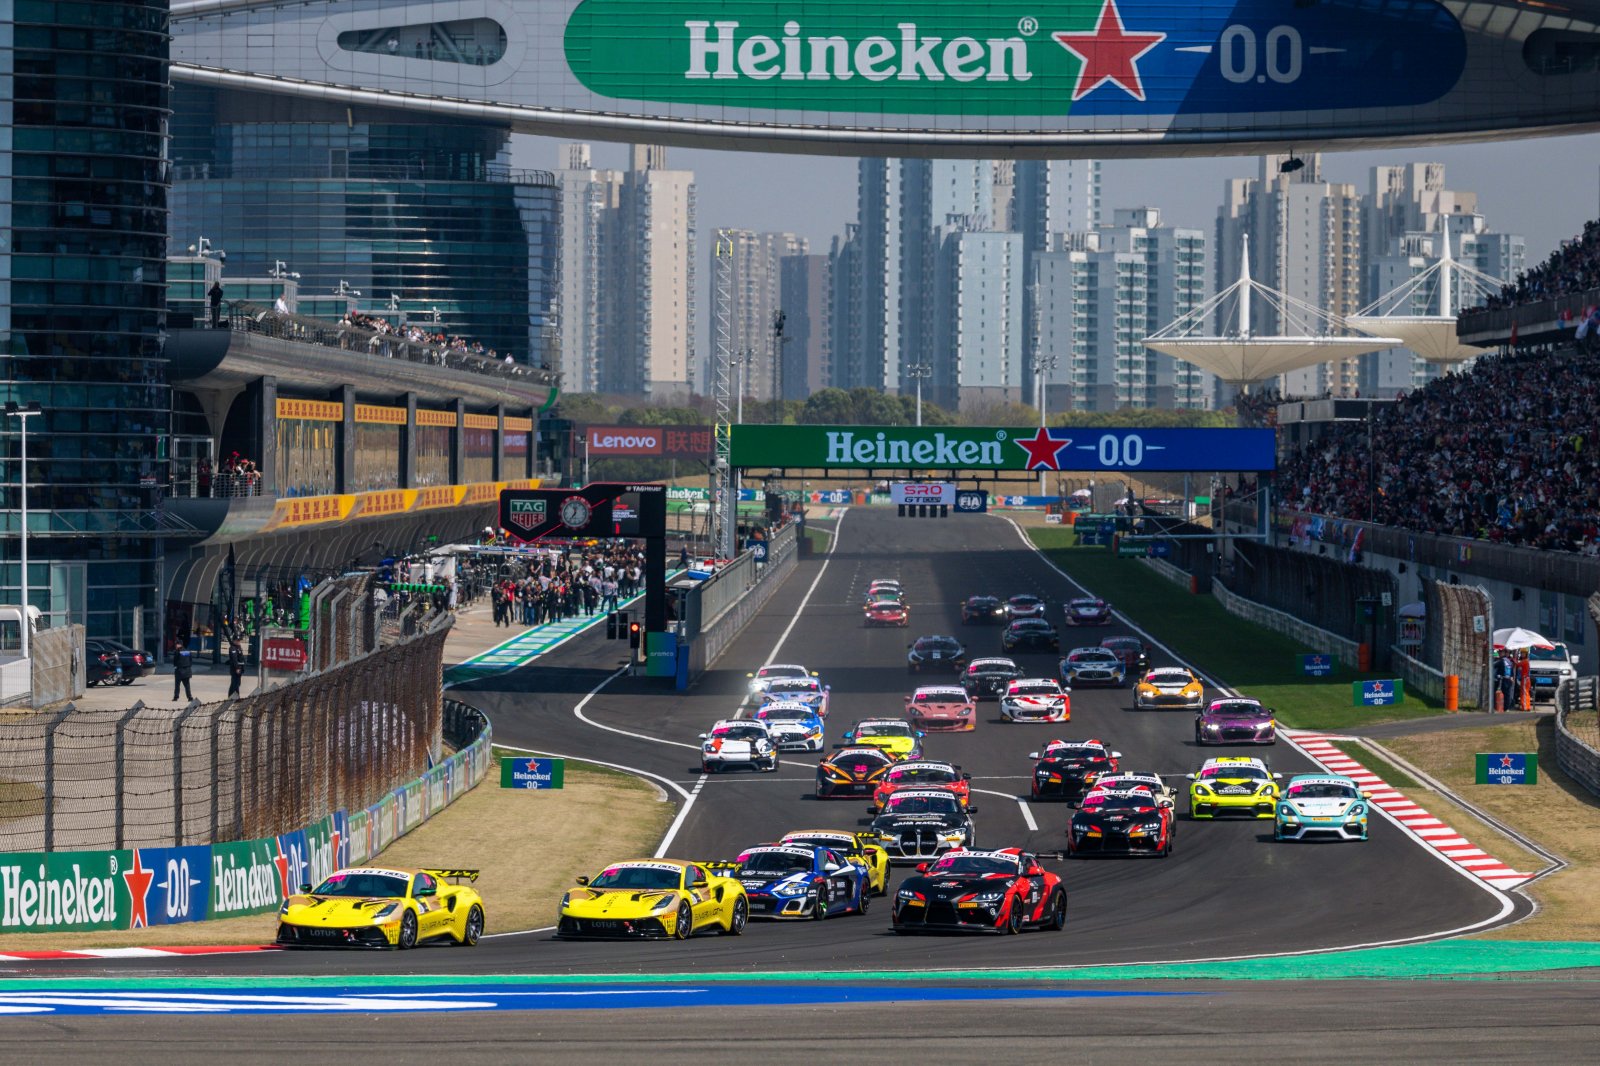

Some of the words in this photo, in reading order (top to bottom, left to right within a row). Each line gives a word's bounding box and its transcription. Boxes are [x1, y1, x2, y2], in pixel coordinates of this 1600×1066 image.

[685, 21, 1033, 81] Heineken
[1220, 24, 1303, 83] 0.0
[593, 432, 656, 448] Lenovo
[666, 431, 712, 452] 联想
[826, 432, 1003, 465] Heineken
[1099, 434, 1143, 466] 0.0
[904, 485, 942, 495] SRO
[513, 502, 543, 511] TAG
[512, 513, 544, 528] HEUER
[1364, 691, 1393, 699] Heineken
[514, 771, 551, 781] Heineken
[1488, 767, 1524, 775] Heineken
[213, 851, 277, 912] Heineken
[1, 863, 117, 926] Heineken
[167, 858, 189, 918] 0.0
[310, 929, 336, 937] LOTUS
